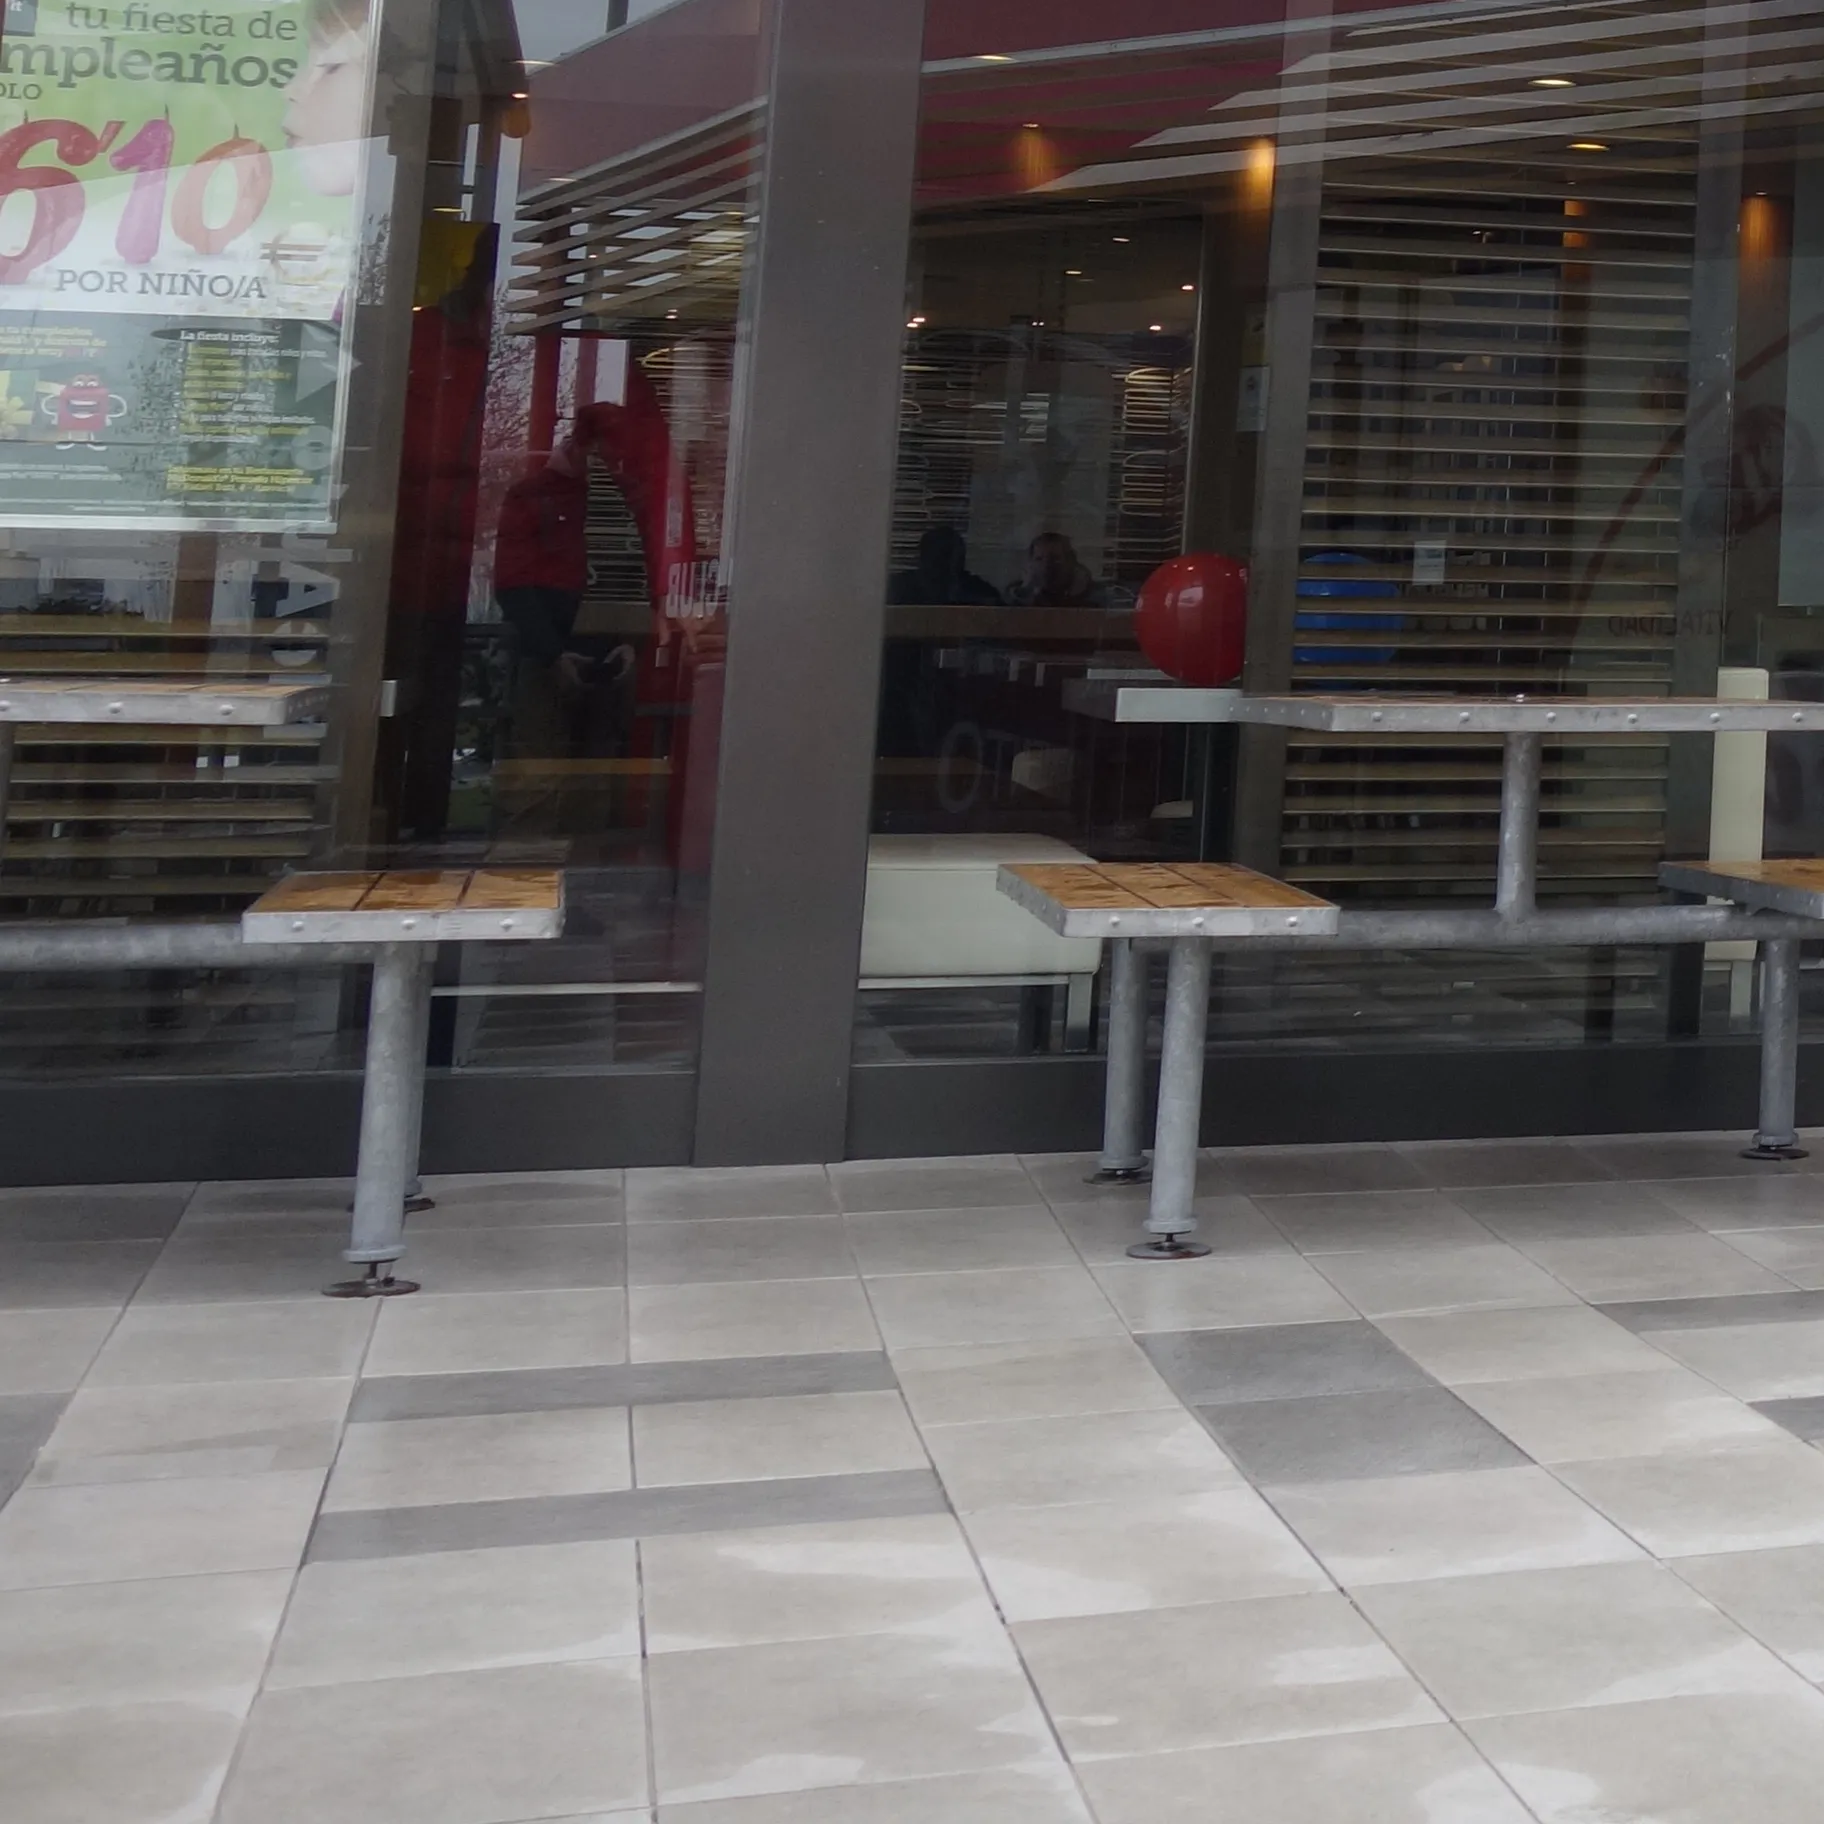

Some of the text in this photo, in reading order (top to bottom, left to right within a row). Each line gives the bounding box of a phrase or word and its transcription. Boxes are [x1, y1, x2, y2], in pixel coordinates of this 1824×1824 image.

[66, 1, 298, 42] tu fiesta de
[0, 36, 299, 88] mpleaños
[55, 268, 267, 299] POR NIÑO/A
